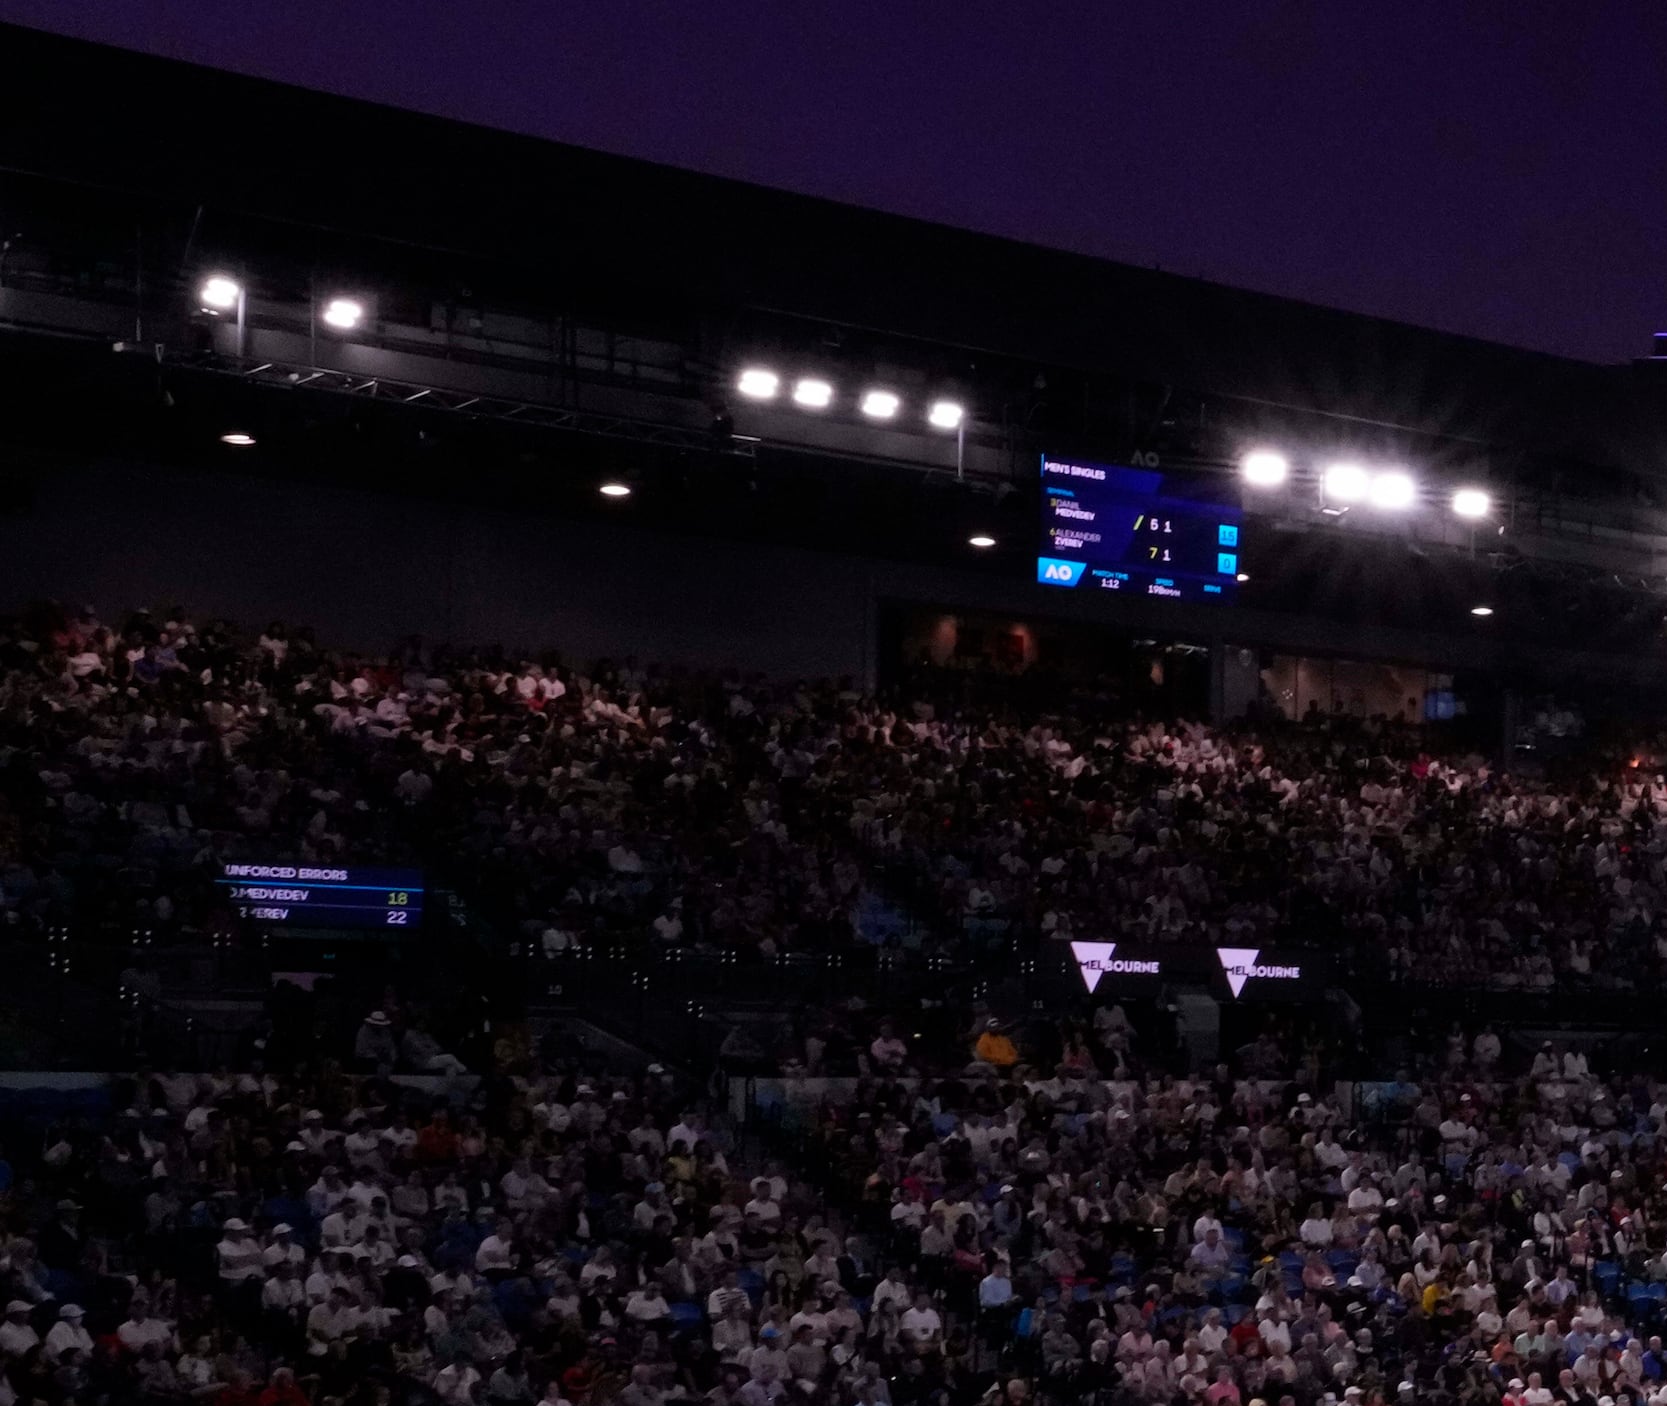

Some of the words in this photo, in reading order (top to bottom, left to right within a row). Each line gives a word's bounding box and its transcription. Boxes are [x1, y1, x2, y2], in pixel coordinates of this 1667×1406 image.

[1071, 466, 1105, 480] SINGLES
[1055, 508, 1095, 521] MEDVEDEV
[1164, 520, 1172, 533] 1
[1220, 530, 1235, 542] 15
[1055, 536, 1084, 548] ZVEREV
[1149, 546, 1158, 559] 7
[1162, 549, 1171, 562] 1
[1045, 564, 1072, 580] AO
[1101, 578, 1120, 589] 1:12
[225, 864, 296, 879] UNFORCED
[298, 867, 348, 881] ERRORS
[388, 892, 408, 906] 18
[387, 911, 407, 924] 22
[1078, 960, 1160, 973] MELBOURNE
[1224, 965, 1300, 978] MELBOURNE
